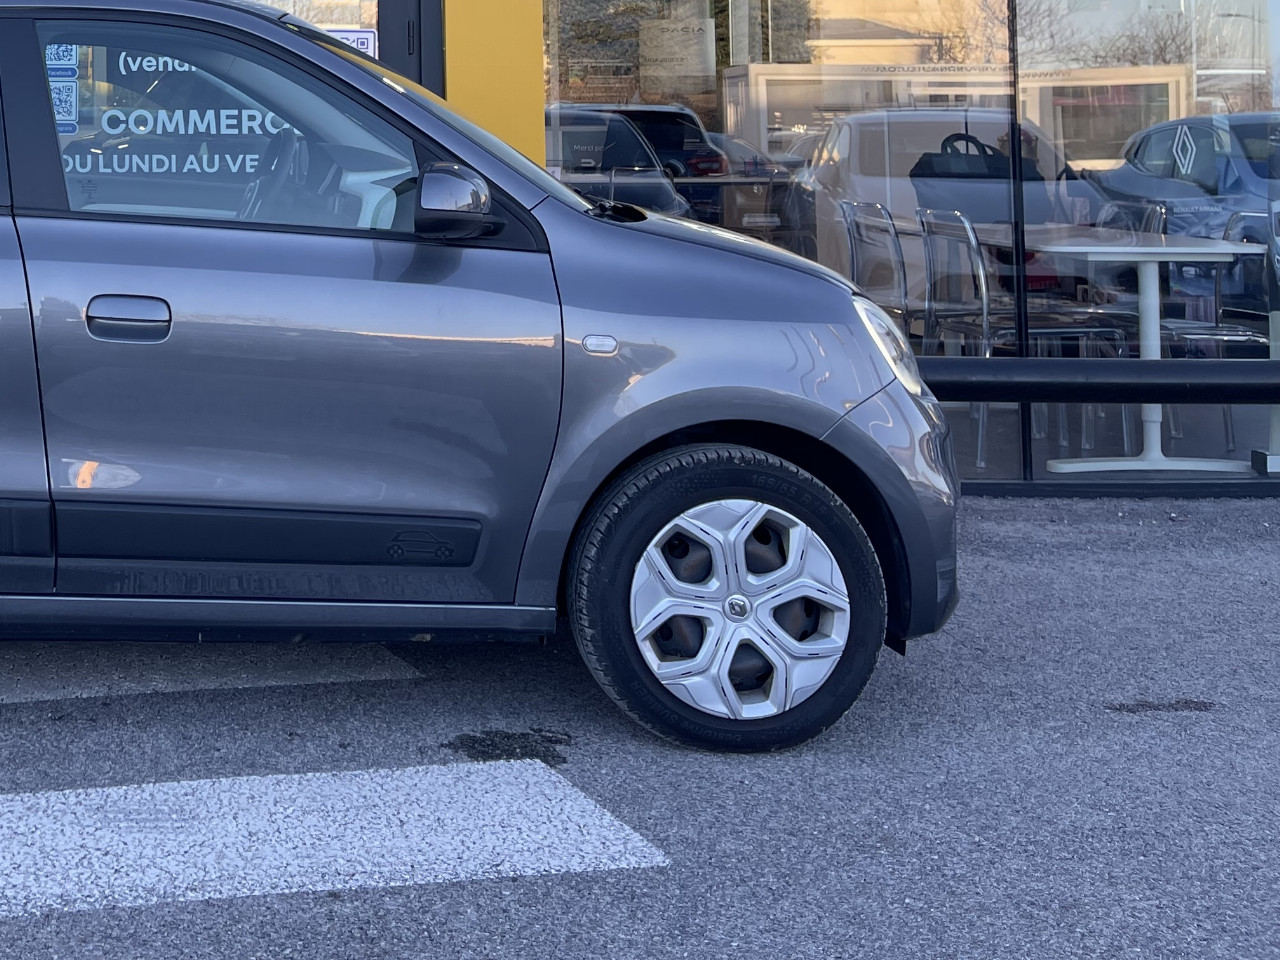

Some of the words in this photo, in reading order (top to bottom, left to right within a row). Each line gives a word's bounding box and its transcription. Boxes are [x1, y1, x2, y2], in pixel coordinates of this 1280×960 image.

[102, 110, 304, 135] COMMERC
[99, 155, 176, 173] LUNDI
[183, 154, 220, 173] AU
